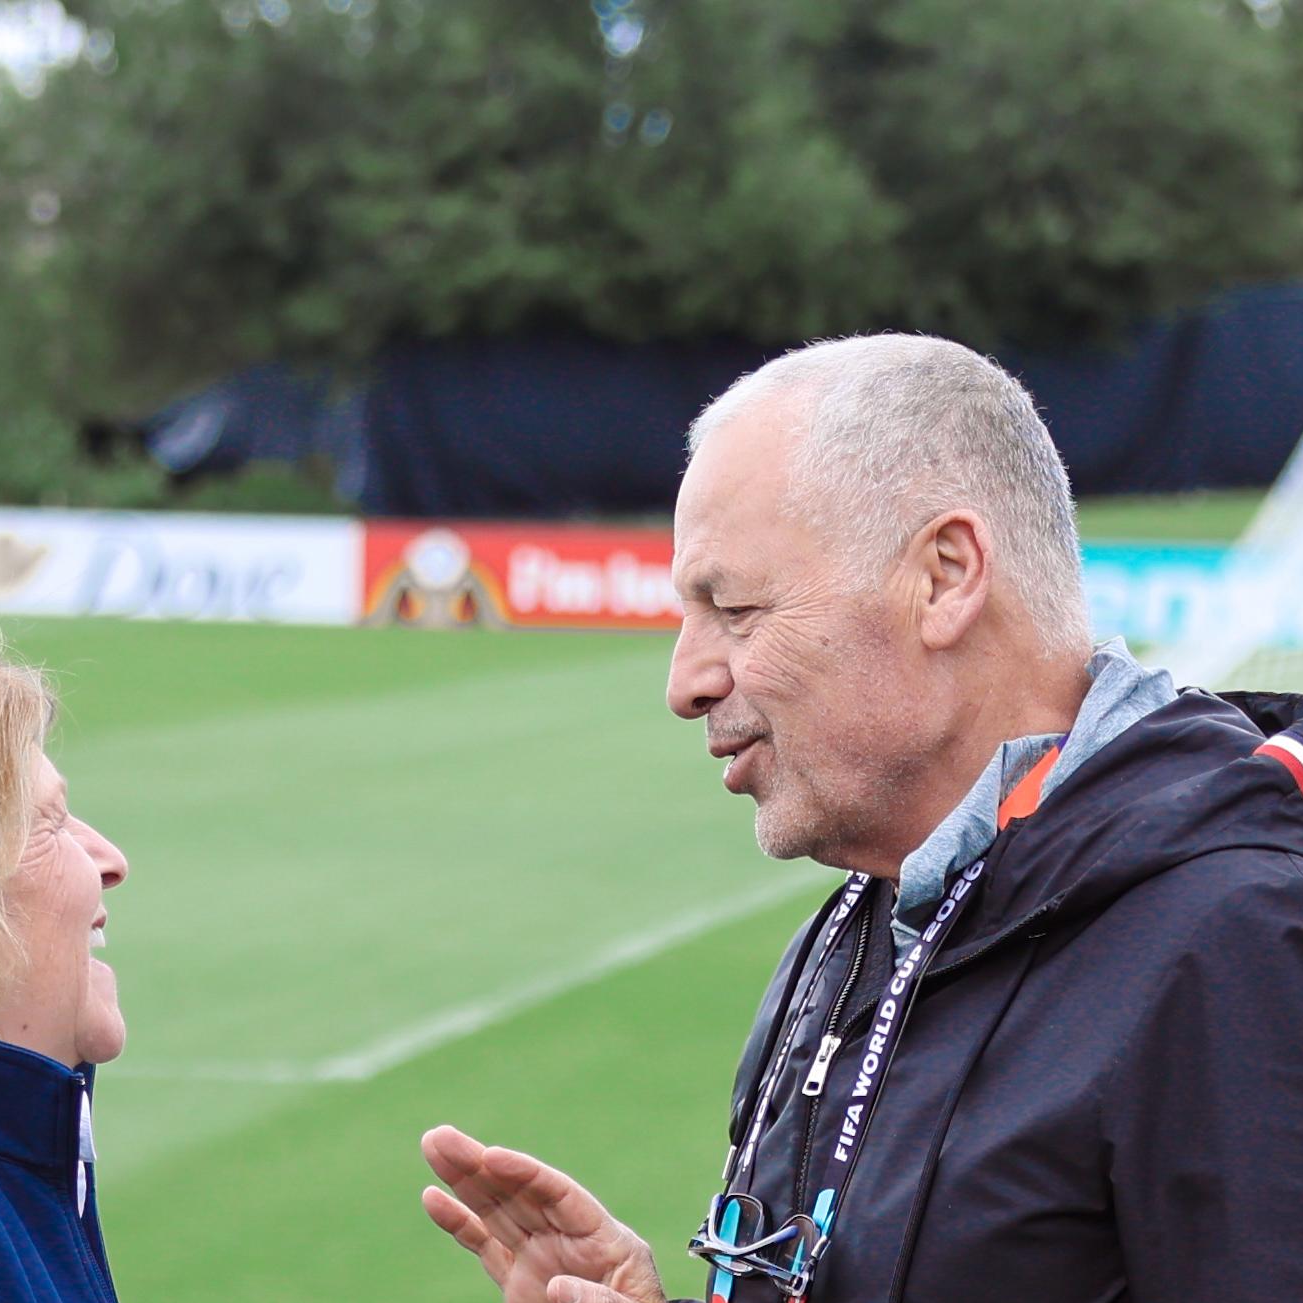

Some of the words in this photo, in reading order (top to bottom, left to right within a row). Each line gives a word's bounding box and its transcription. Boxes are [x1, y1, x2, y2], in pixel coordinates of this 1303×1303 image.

[834, 1104, 864, 1163] FIFA
[852, 999, 897, 1098] WORLD
[891, 944, 923, 996] CUP
[922, 858, 985, 943] 2026
